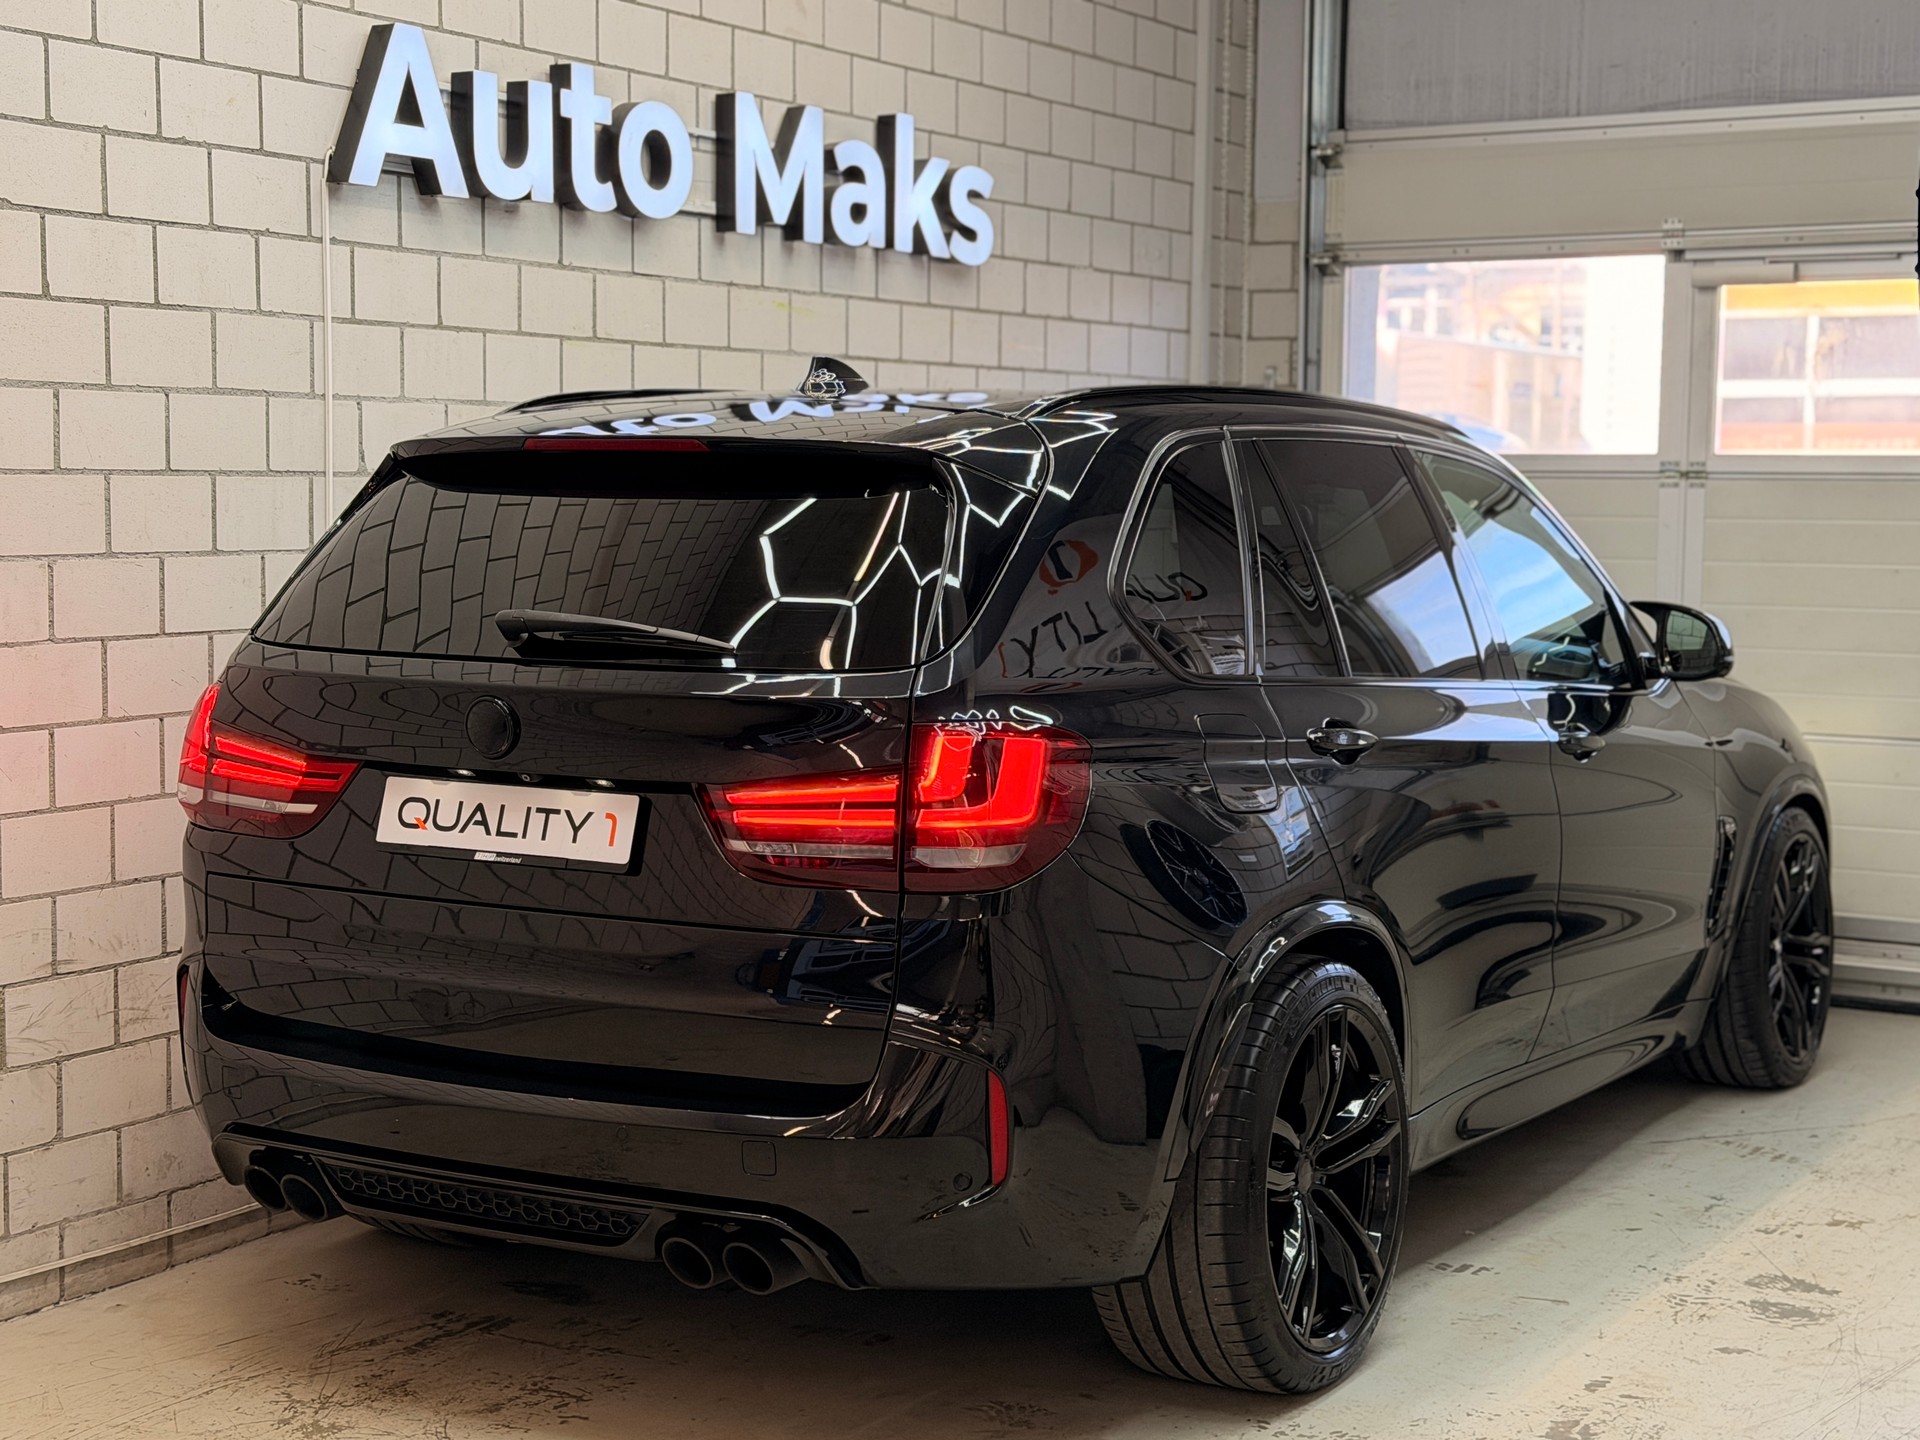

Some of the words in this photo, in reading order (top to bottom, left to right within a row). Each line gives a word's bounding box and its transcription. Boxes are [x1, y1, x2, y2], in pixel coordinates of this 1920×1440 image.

[346, 22, 693, 220] Auto
[732, 91, 995, 267] Maks
[397, 796, 595, 844] QUALITY
